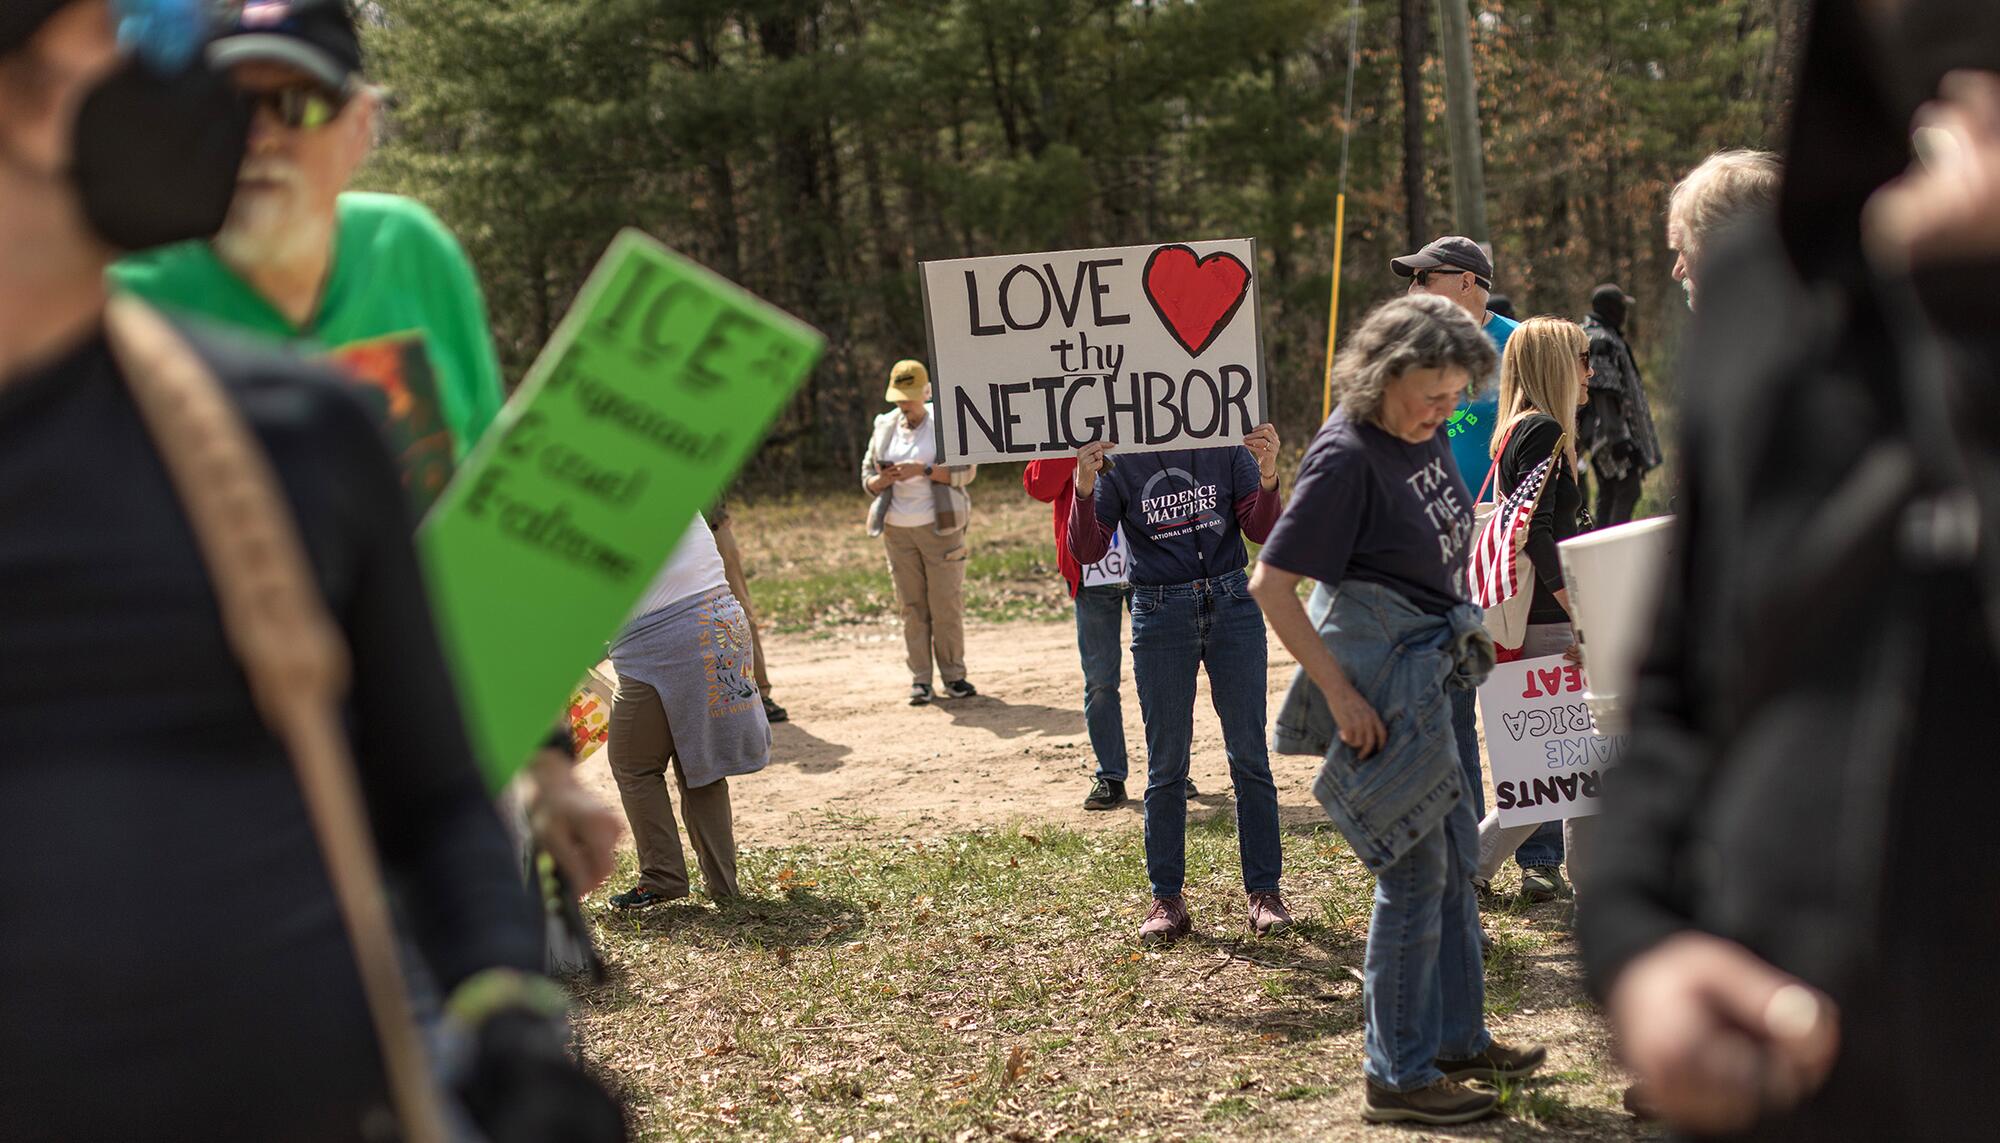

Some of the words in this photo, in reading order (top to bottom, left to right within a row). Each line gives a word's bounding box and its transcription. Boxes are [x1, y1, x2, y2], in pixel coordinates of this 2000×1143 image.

[964, 258, 1131, 336] LOVE
[590, 260, 766, 396] ICE
[1050, 331, 1125, 383] thy
[954, 364, 1254, 456] NEIGHBOR
[1447, 423, 1465, 437] et
[1141, 484, 1217, 513] EVIDENCE
[1406, 457, 1449, 500] TAX
[1146, 496, 1217, 525] MATTERS
[1424, 486, 1462, 530] THE
[1182, 522, 1208, 536] HISORY
[1522, 665, 1588, 698] EAT
[1503, 702, 1593, 741] RICA
[1497, 769, 1604, 809] RANTS
